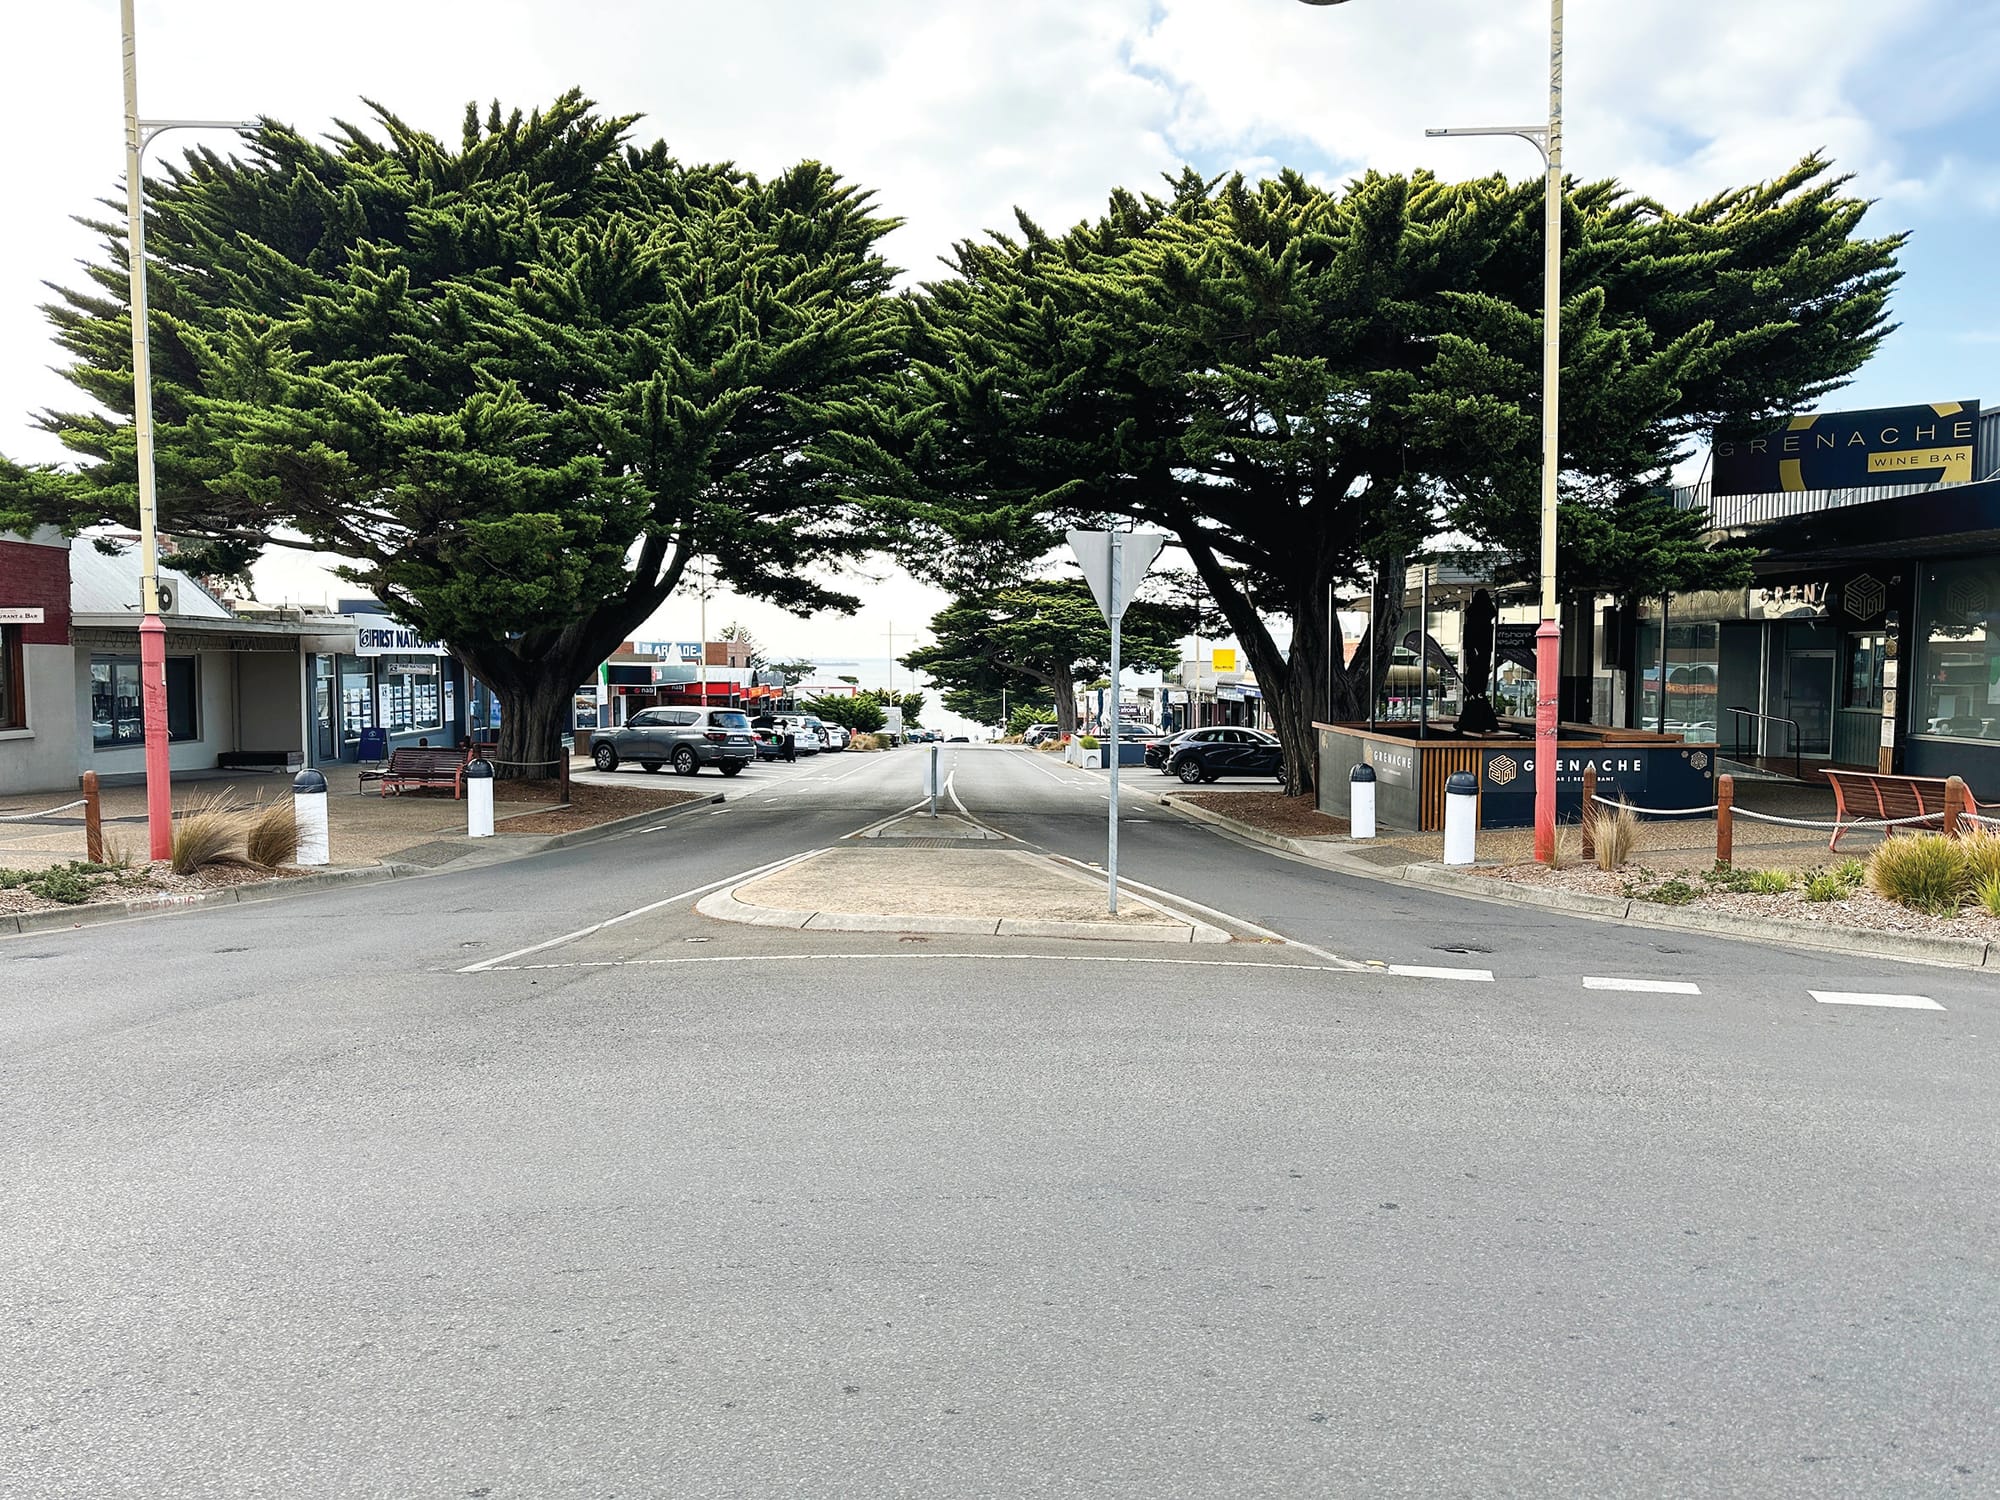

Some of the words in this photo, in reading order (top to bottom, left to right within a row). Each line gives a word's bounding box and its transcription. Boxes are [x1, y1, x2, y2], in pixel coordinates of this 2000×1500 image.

[1717, 421, 1973, 457] GRENACHE
[1873, 455, 1919, 467] WINE
[1929, 452, 1967, 463] BAR
[372, 629, 394, 648] FIRST
[653, 645, 697, 657] ARDE
[1373, 750, 1412, 769] GRENACHE
[1523, 759, 1642, 772] GENACHE
